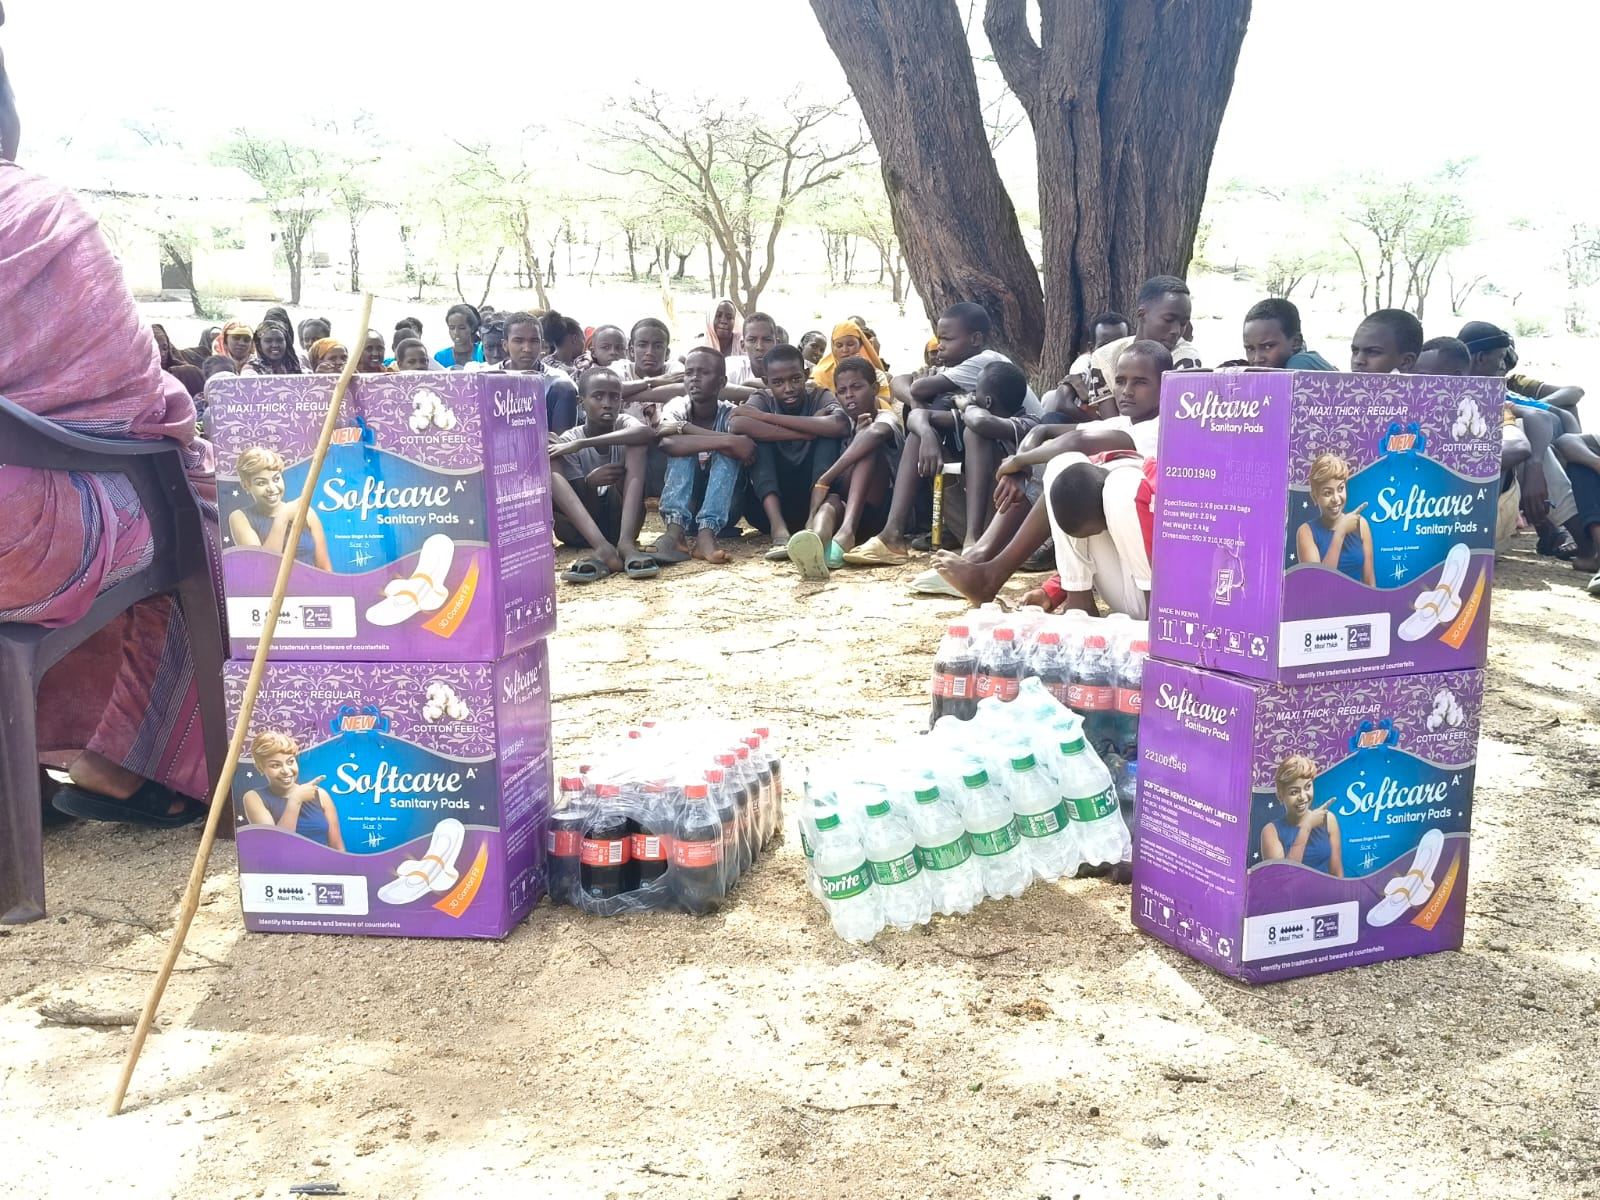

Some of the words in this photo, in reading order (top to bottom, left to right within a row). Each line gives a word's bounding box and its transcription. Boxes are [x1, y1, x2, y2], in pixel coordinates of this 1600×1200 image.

[227, 403, 252, 413] MAXI
[255, 403, 287, 412] THICK
[295, 402, 346, 411] REGULR
[1175, 390, 1260, 428] Softcare
[1309, 406, 1332, 416] MAXI
[1334, 406, 1360, 416] THICK
[1367, 406, 1408, 416] REGULAR
[331, 428, 362, 444] NEW
[1210, 422, 1242, 434] Sanitary
[1244, 423, 1264, 432] Pads
[400, 436, 439, 444] COTTON
[442, 436, 466, 444] FEEL
[1386, 434, 1416, 451] NEW
[1442, 444, 1472, 452] COTTON
[1474, 444, 1491, 452] FEEL
[318, 476, 450, 520] Softcare
[1371, 484, 1473, 531] Softcare
[377, 514, 425, 525] Sanitary
[429, 513, 459, 524] Pads
[1416, 524, 1453, 536] Sanitary
[1454, 522, 1477, 532] Pads
[252, 609, 260, 622] 8
[305, 609, 314, 621] 2
[1159, 606, 1174, 614] MADE
[1181, 610, 1198, 618] KENYA
[1304, 633, 1312, 648] 8
[1350, 628, 1357, 642] 2
[1316, 670, 1324, 678] the
[1326, 668, 1351, 676] trademark
[1362, 664, 1380, 672] beware
[1386, 660, 1414, 670] counterfeits
[270, 691, 300, 699] THICK
[310, 691, 360, 699] REGULAR
[1155, 683, 1227, 724] Softcare
[1276, 711, 1300, 721] MAXI
[1302, 708, 1329, 718] THICK
[1337, 704, 1380, 716] REGULAR
[341, 715, 376, 731] NEW
[414, 724, 453, 733] COTTON
[1184, 718, 1212, 736] Sanitary
[1212, 728, 1230, 741] Pads
[1357, 730, 1390, 748] NEW
[1416, 734, 1448, 743] COTTON
[1450, 732, 1468, 740] FEEL
[331, 761, 462, 803] Softcare
[390, 798, 438, 810] Sanitary
[440, 798, 470, 809] Pads
[1339, 776, 1448, 822] Softcare
[1188, 798, 1214, 814] COMPANY
[1214, 808, 1238, 823] LIMITED
[1386, 812, 1426, 824] Sanitary
[1428, 807, 1452, 820] Pads
[265, 885, 274, 898] 8
[318, 886, 328, 898] 2
[823, 874, 860, 894] Sprite
[1140, 883, 1154, 895] MADE
[448, 899, 458, 910] 3D
[259, 918, 280, 926] Identify
[1268, 926, 1276, 940] 8
[1316, 919, 1324, 933] 2
[1260, 963, 1280, 972] Identify
[1291, 957, 1318, 967] trademark
[1329, 952, 1348, 960] beware
[1354, 946, 1384, 956] counterfeits
